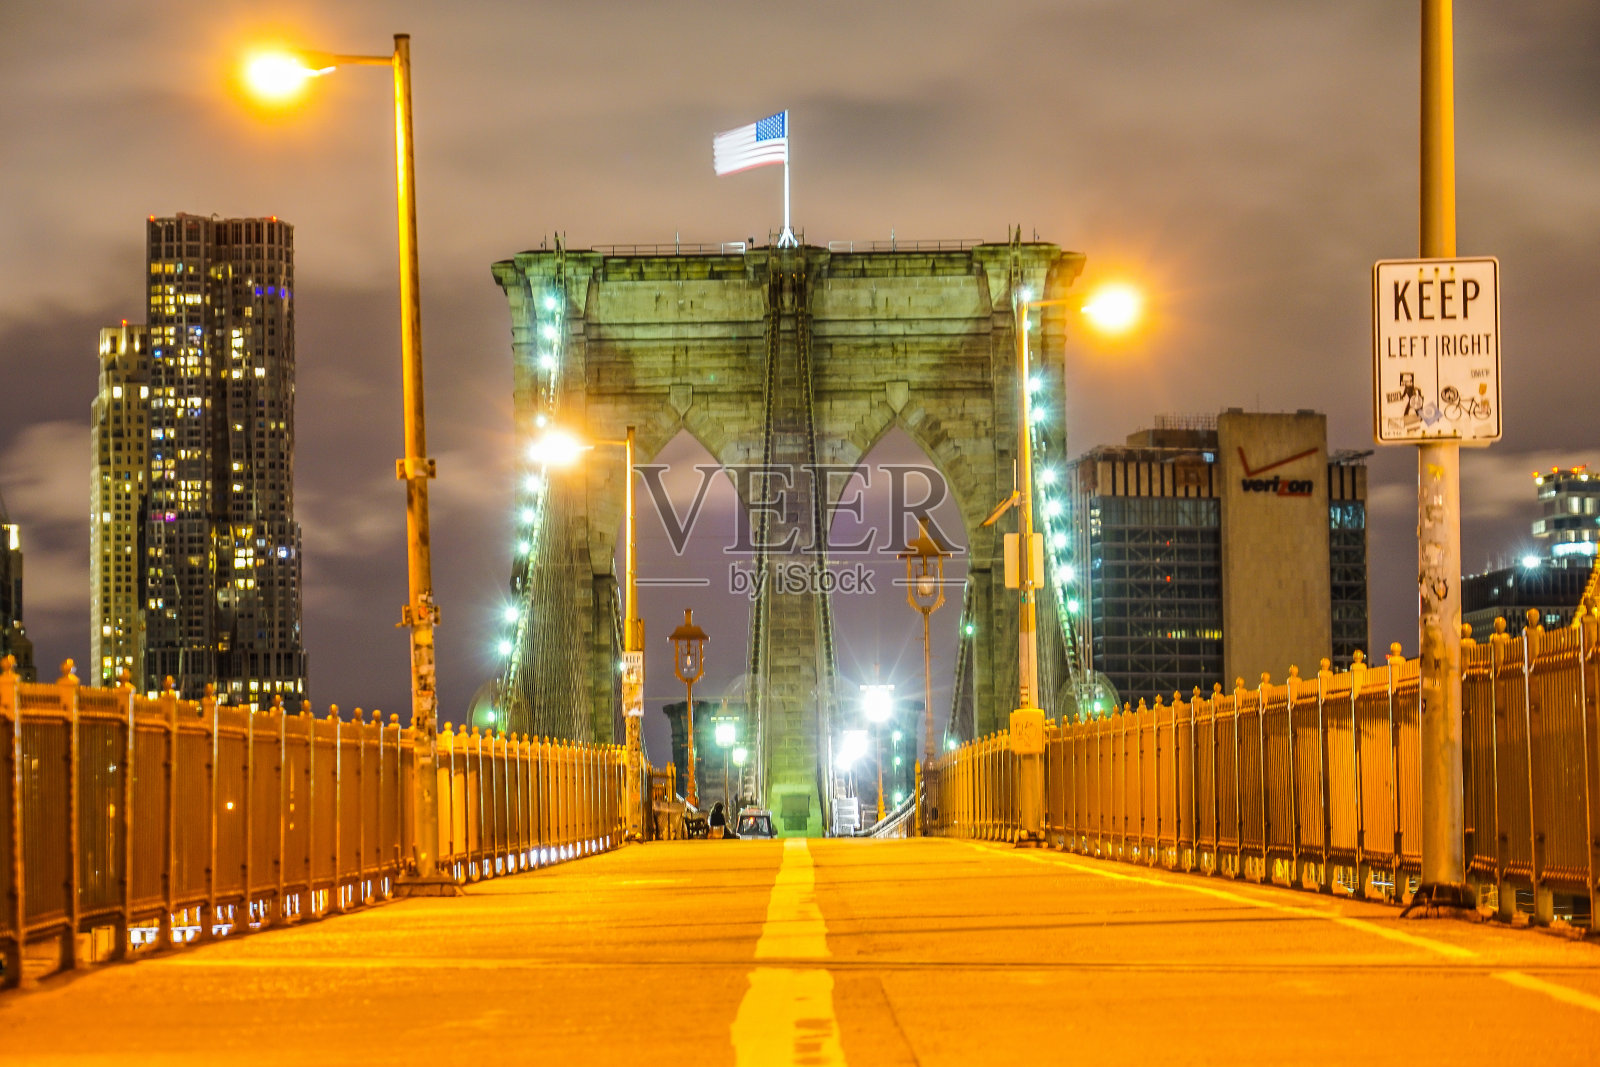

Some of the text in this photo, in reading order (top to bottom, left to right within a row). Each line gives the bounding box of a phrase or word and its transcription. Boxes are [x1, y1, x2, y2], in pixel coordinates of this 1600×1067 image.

[1393, 279, 1480, 321] KEEP
[1387, 333, 1492, 358] LEFT RIGHT
[1241, 476, 1313, 495] verizon
